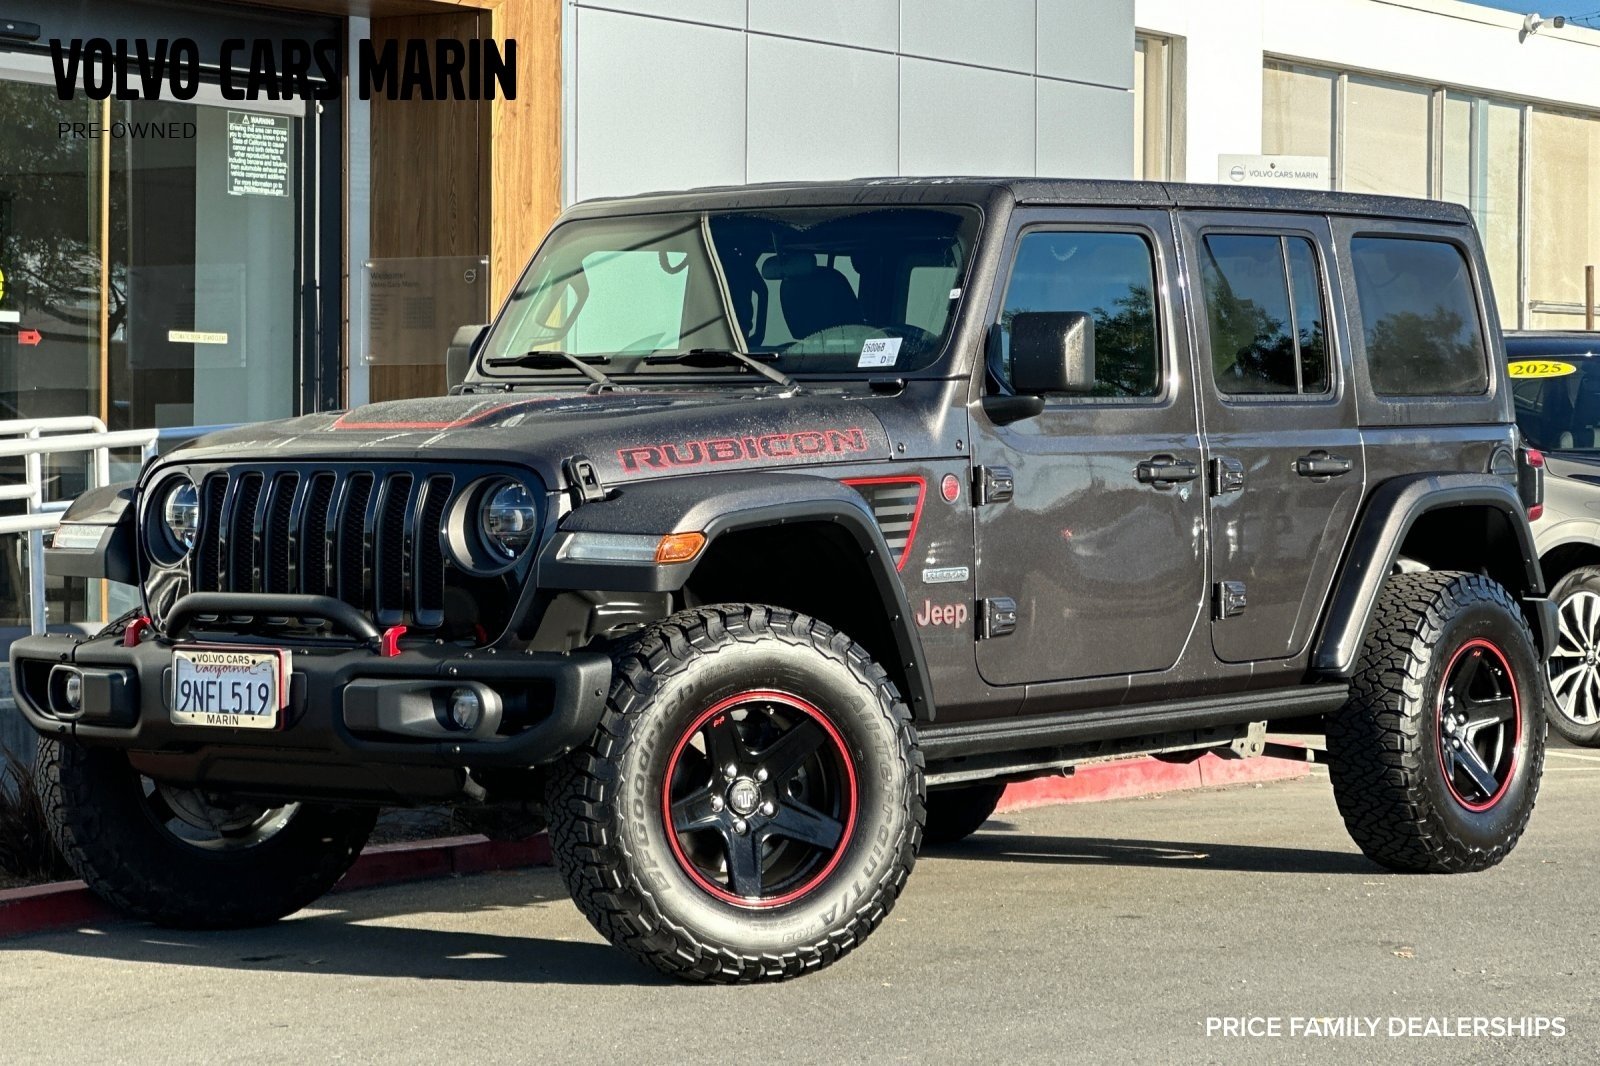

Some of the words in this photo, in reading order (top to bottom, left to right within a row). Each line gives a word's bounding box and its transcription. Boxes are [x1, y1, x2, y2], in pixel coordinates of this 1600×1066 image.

[251, 116, 275, 126] WARNING
[1249, 170, 1273, 178] VOLVO
[1274, 170, 1293, 179] CARS
[1513, 363, 1562, 375] 2025
[617, 428, 867, 473] RUBICON
[916, 599, 968, 629] Jeep
[196, 654, 225, 664] VOLVO
[226, 656, 250, 665] CARS
[180, 680, 270, 716] 9NFL519
[206, 714, 239, 725] MARIN
[632, 682, 695, 892] BFGoodrich
